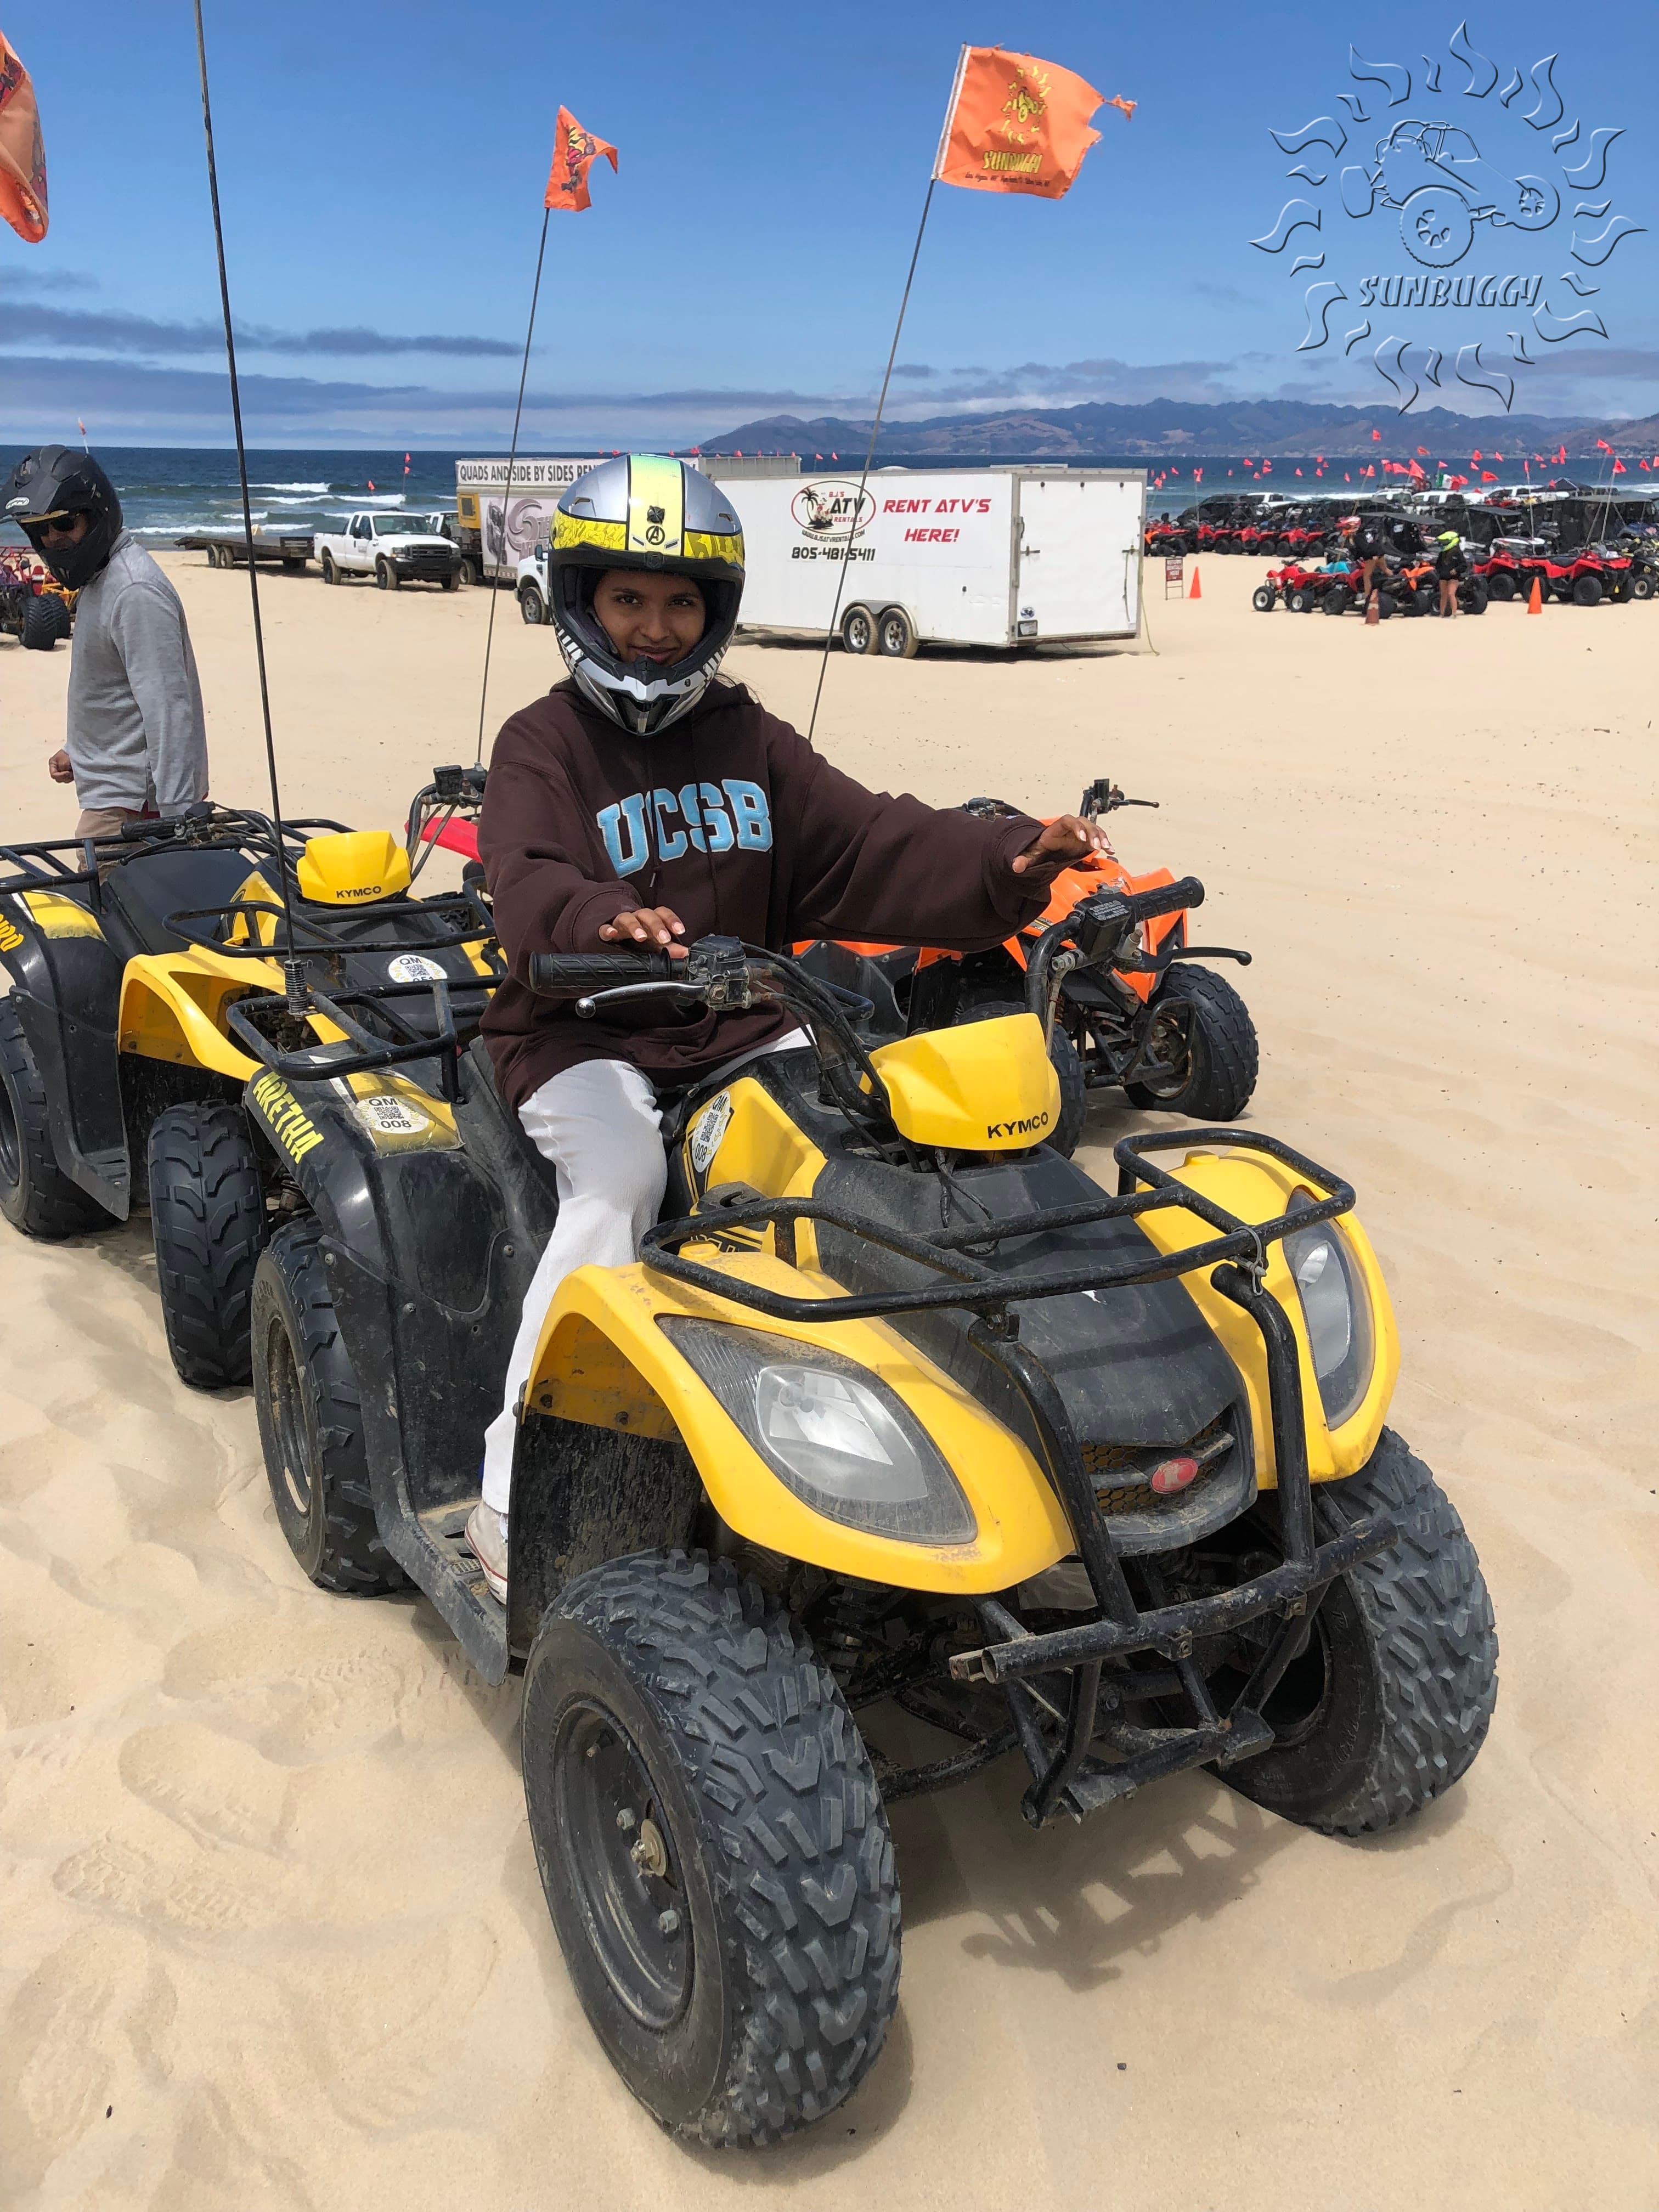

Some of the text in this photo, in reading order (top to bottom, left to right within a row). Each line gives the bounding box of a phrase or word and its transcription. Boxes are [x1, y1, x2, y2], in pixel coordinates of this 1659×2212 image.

[460, 465, 488, 481] QUADS
[491, 465, 510, 481] AND
[512, 465, 531, 482] SIDE
[534, 465, 545, 481] BY
[548, 465, 574, 482] SIDES
[830, 498, 866, 514] ATV
[883, 499, 992, 513] RENT ATV'S
[904, 528, 960, 543] HERE!
[792, 547, 876, 561] 805-481-5411
[596, 779, 773, 879] UCSB
[336, 885, 382, 899] KYMCO
[368, 1098, 398, 1107] QM
[252, 1071, 325, 1164] ARETHA
[380, 1120, 412, 1128] 008
[988, 1111, 1048, 1139] KYMCO
[695, 1142, 708, 1163] 008
